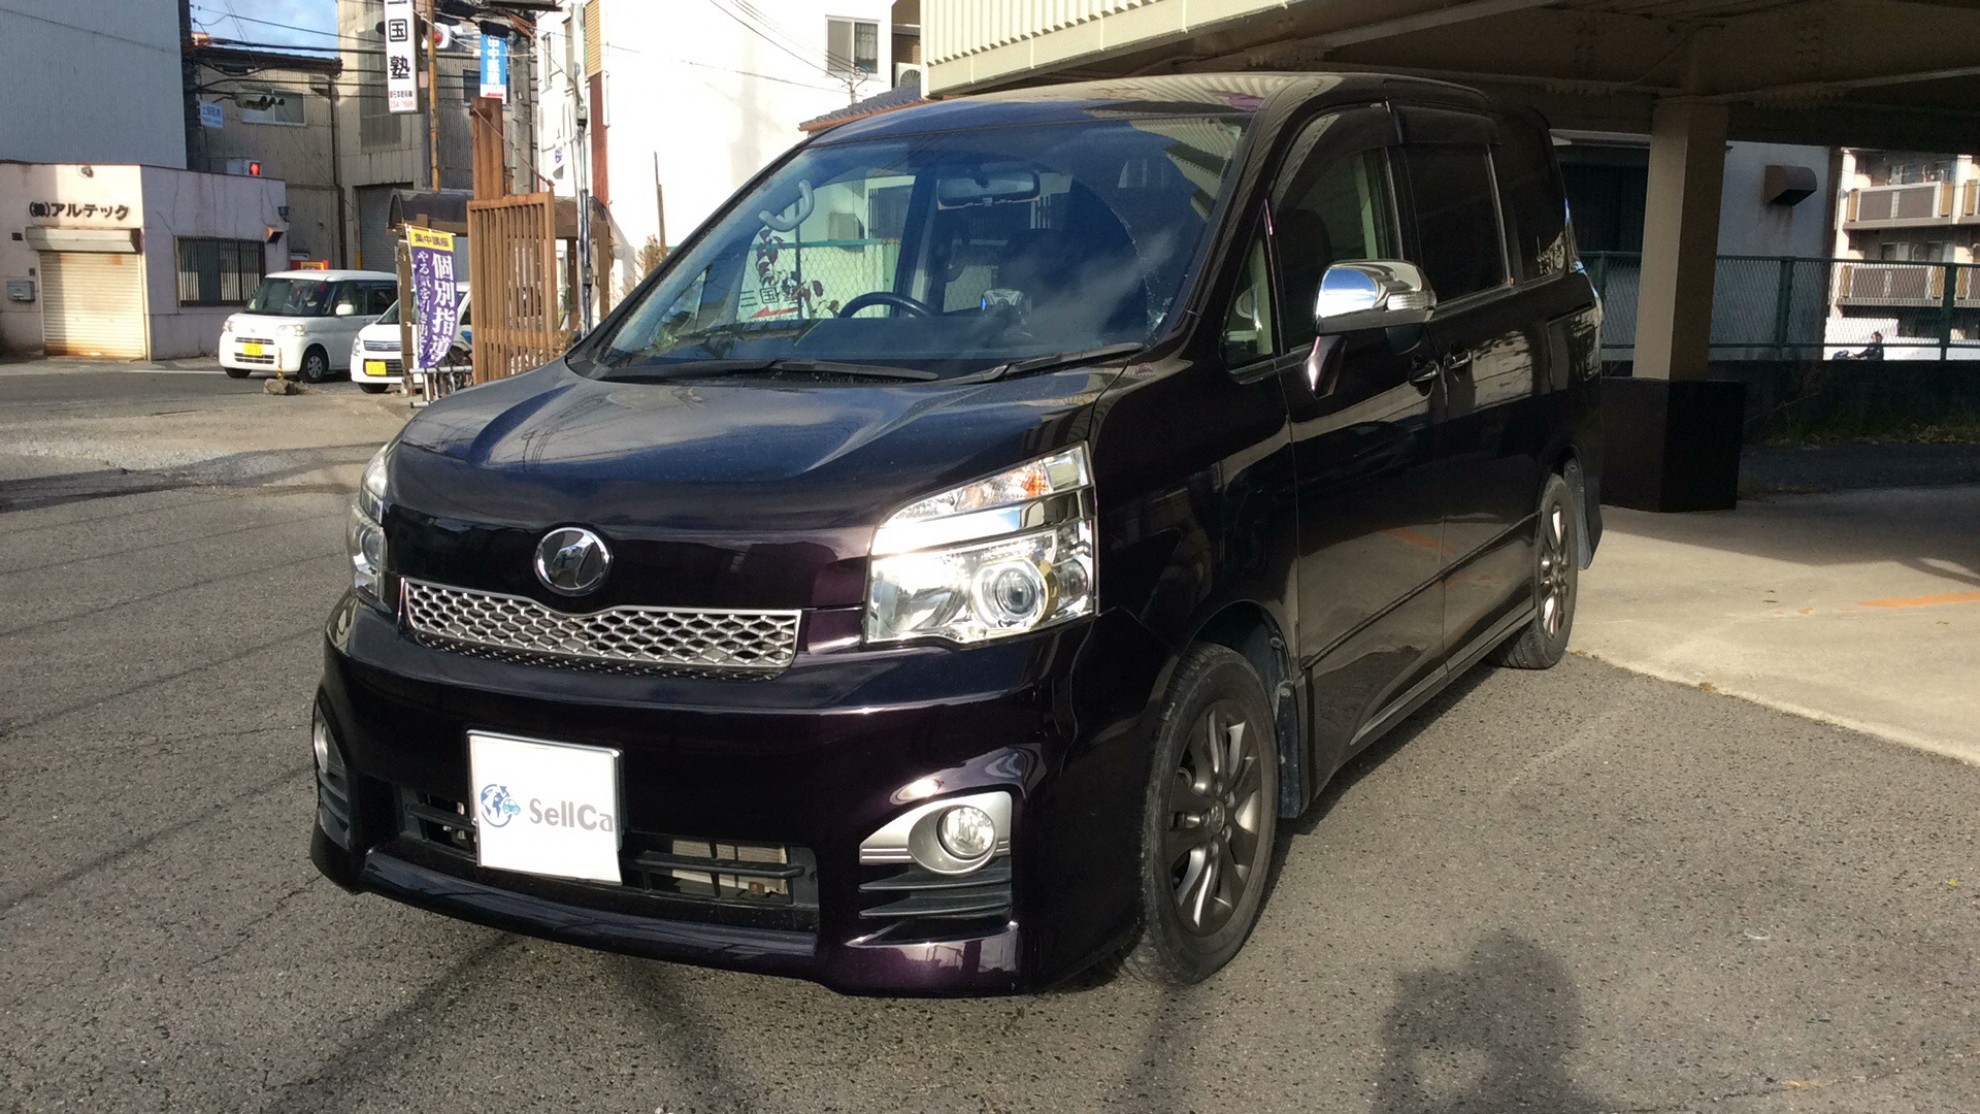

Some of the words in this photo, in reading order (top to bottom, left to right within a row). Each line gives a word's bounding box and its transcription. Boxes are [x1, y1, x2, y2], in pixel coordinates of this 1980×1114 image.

[387, 0, 411, 79] 国塾
[427, 252, 456, 367] 個別指導
